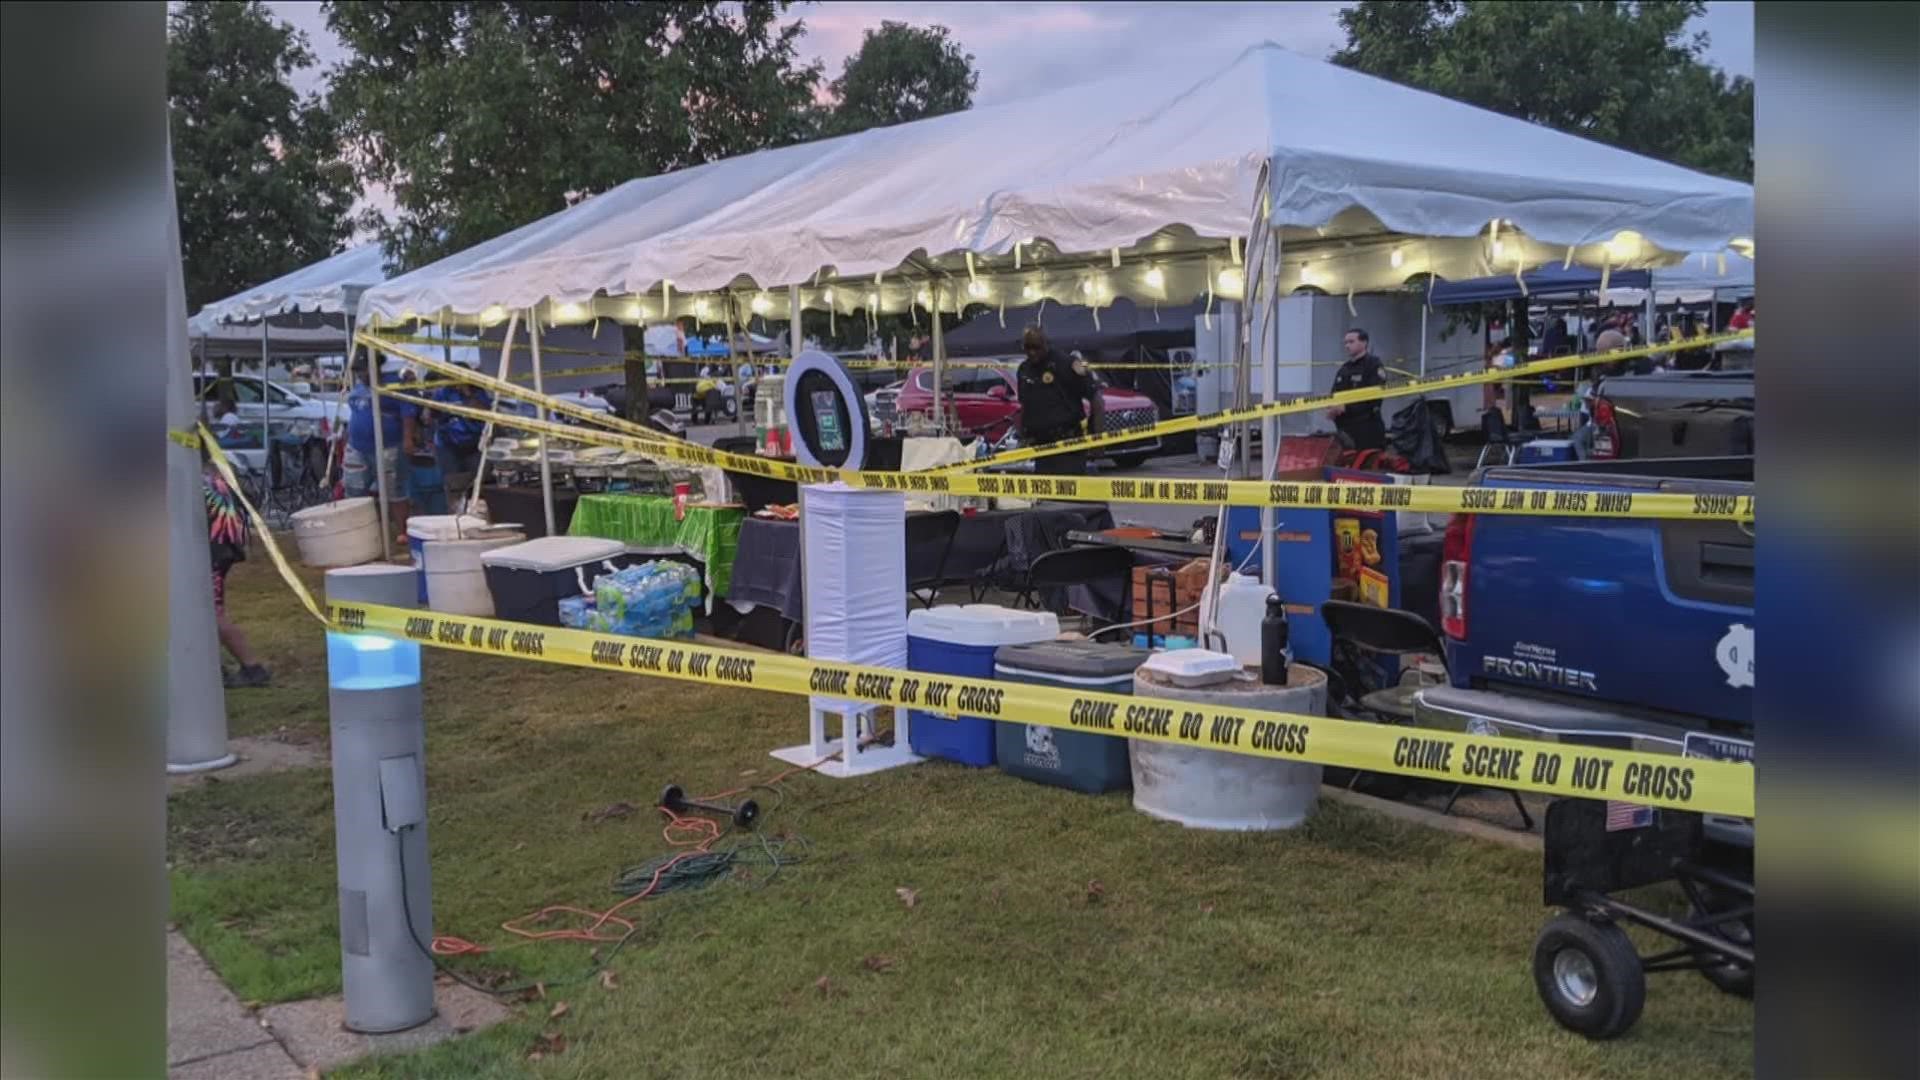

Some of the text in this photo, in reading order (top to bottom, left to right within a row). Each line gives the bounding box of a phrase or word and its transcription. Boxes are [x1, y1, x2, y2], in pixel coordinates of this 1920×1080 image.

[1111, 480, 1228, 501] CRIME SCENE DO NOT CROSS
[1269, 483, 1411, 506] CRIME SCENE DO NOT CROSS
[1461, 489, 1632, 512] CRIME SCENE DO NOT CROSS
[1693, 495, 1737, 515] CROSS
[404, 616, 545, 656] CRIME SCENE DO NOT CROSS
[591, 640, 755, 683] CRIME SCENE DO NOT CROSS
[1482, 655, 1597, 690] FRONTIER
[809, 667, 1004, 715] CRIME SCENE DO NOT CROSS
[1069, 698, 1309, 754] CRIME SCENE DO NOT CROSS
[1393, 736, 1695, 801] CRIME SCENE DO NOT CROSS
